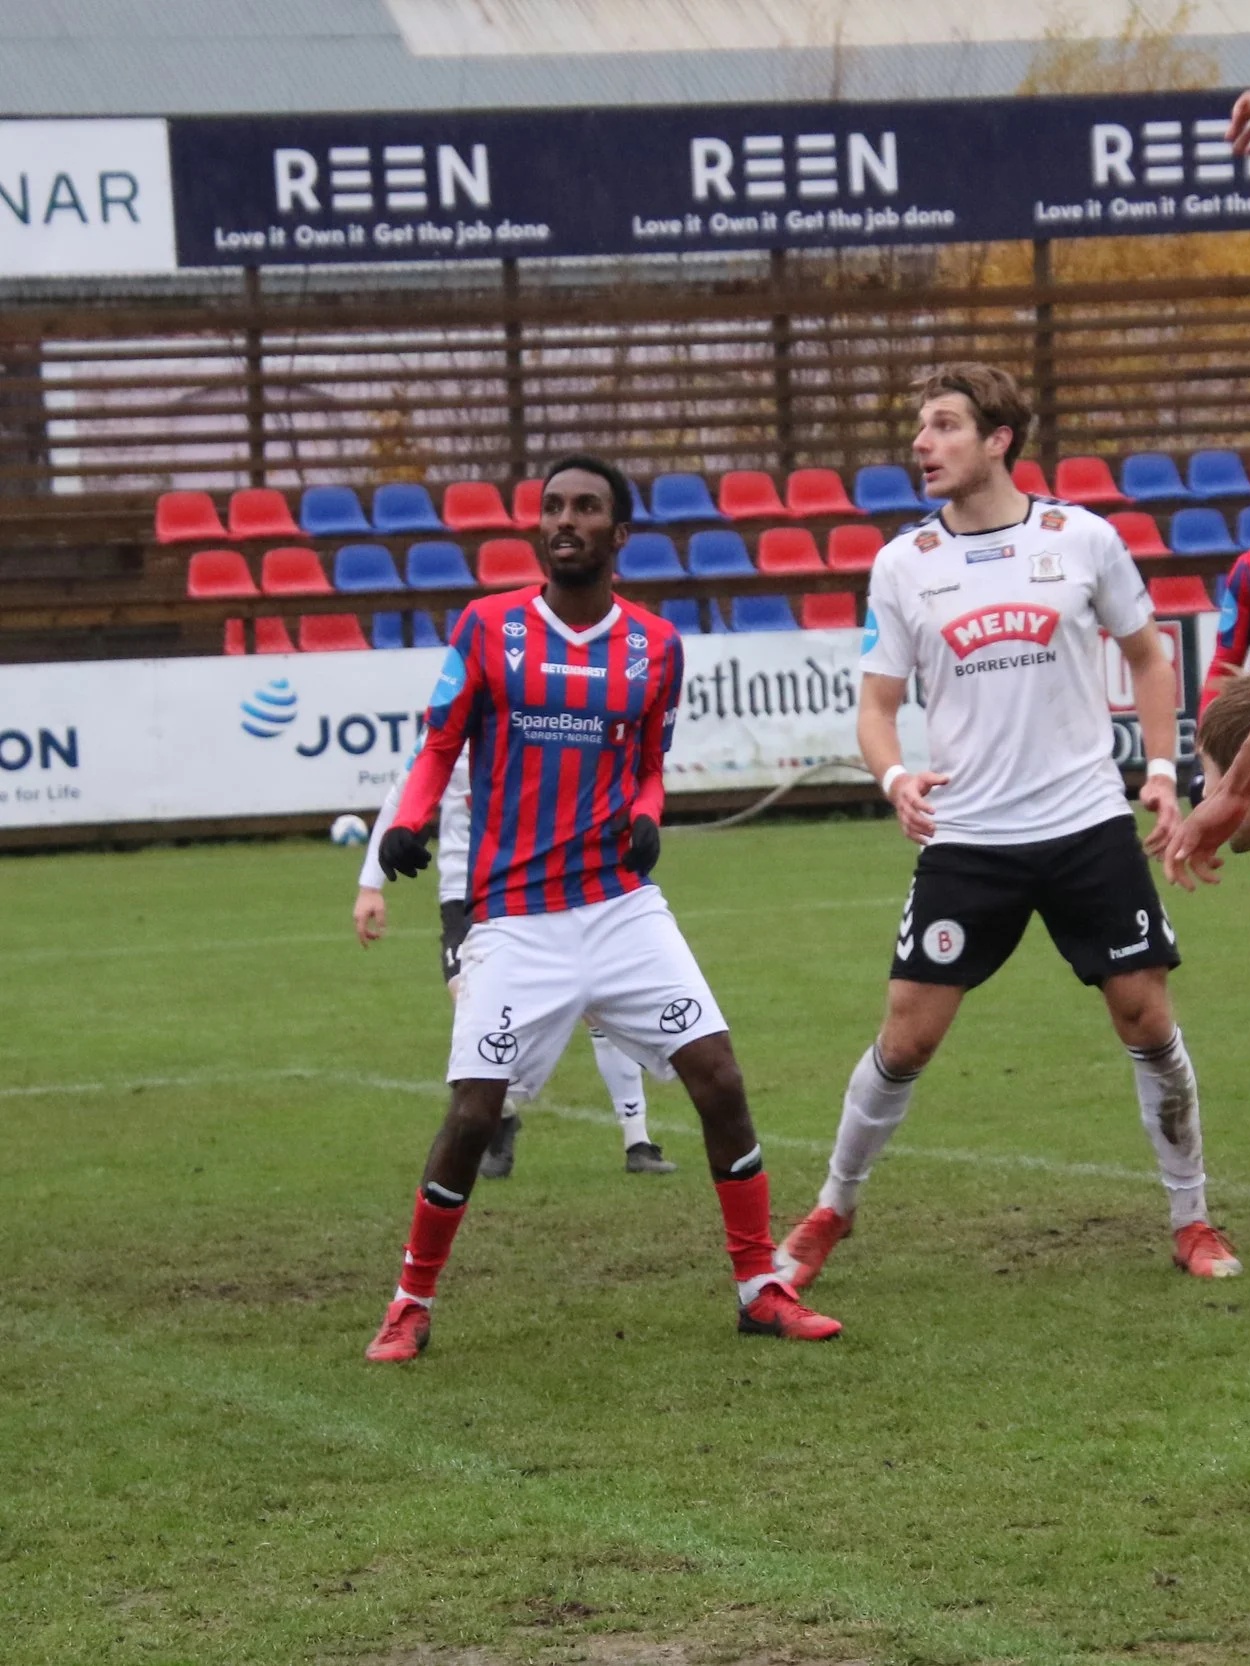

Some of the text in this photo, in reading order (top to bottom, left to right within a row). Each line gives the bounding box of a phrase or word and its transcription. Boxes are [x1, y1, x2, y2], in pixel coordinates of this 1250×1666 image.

[273, 143, 492, 212] REEN
[690, 131, 898, 199] REEN
[633, 206, 955, 236] Love it Own it Get the job done
[1036, 200, 1084, 221] Love
[1086, 200, 1101, 219] it
[1111, 198, 1157, 217] Own
[1160, 196, 1175, 215] it
[1186, 195, 1221, 214] Get
[214, 218, 550, 247] Love it Own it Get the job done
[953, 611, 1048, 647] MENY
[955, 652, 1056, 677] BORREVEIEN
[296, 712, 424, 757] JOT
[511, 711, 604, 732] SpareBank
[524, 731, 602, 743] SØRØST-NORGE
[1136, 909, 1149, 936] 9
[500, 1006, 512, 1030] 5
